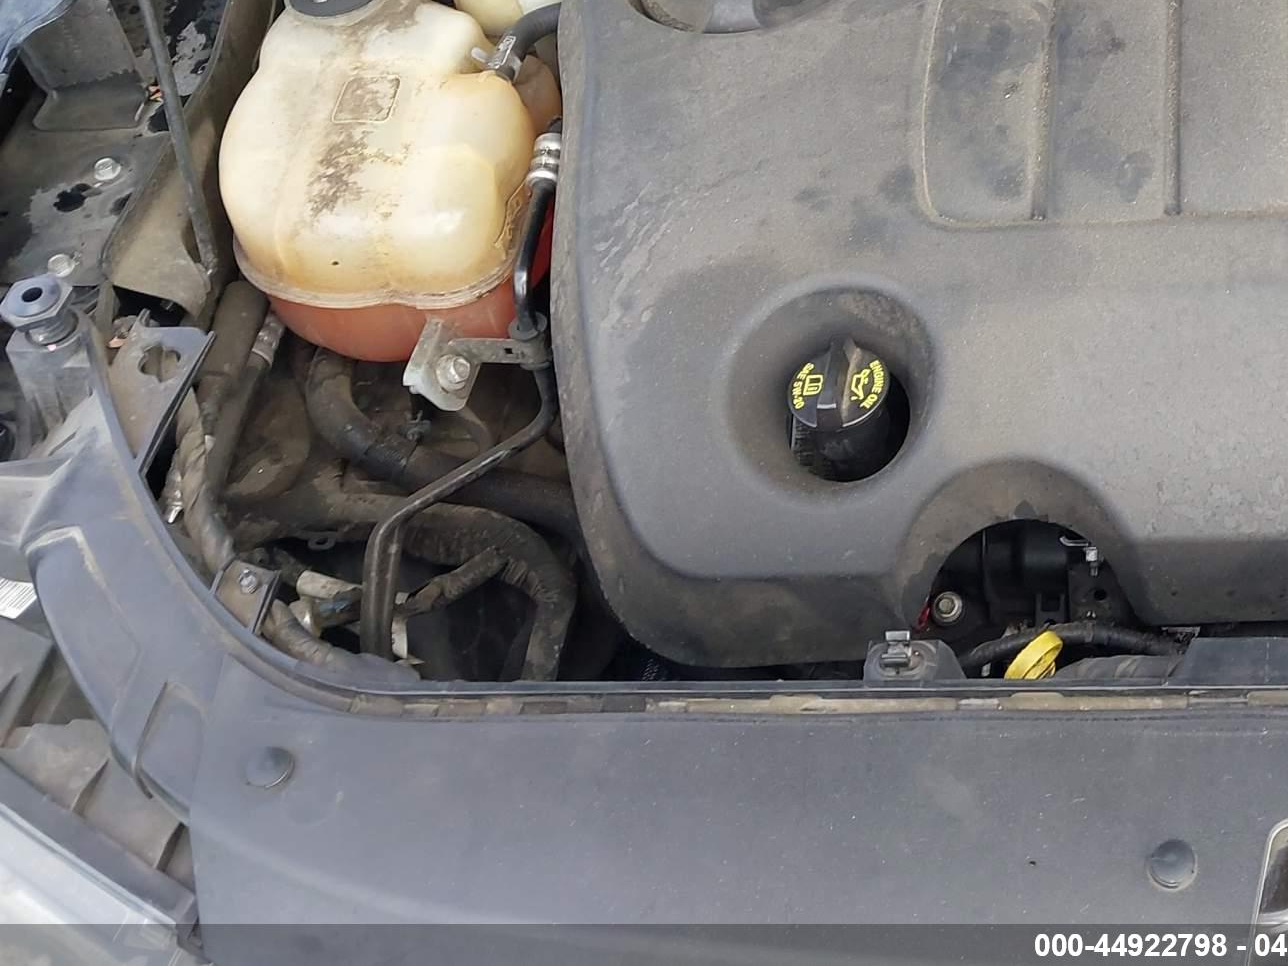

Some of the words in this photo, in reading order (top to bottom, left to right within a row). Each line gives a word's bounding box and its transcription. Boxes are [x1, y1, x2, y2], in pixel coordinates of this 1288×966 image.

[796, 362, 815, 380] SAE
[869, 360, 884, 393] ENGINE
[792, 381, 805, 410] 5W-20
[860, 394, 879, 409] OIL
